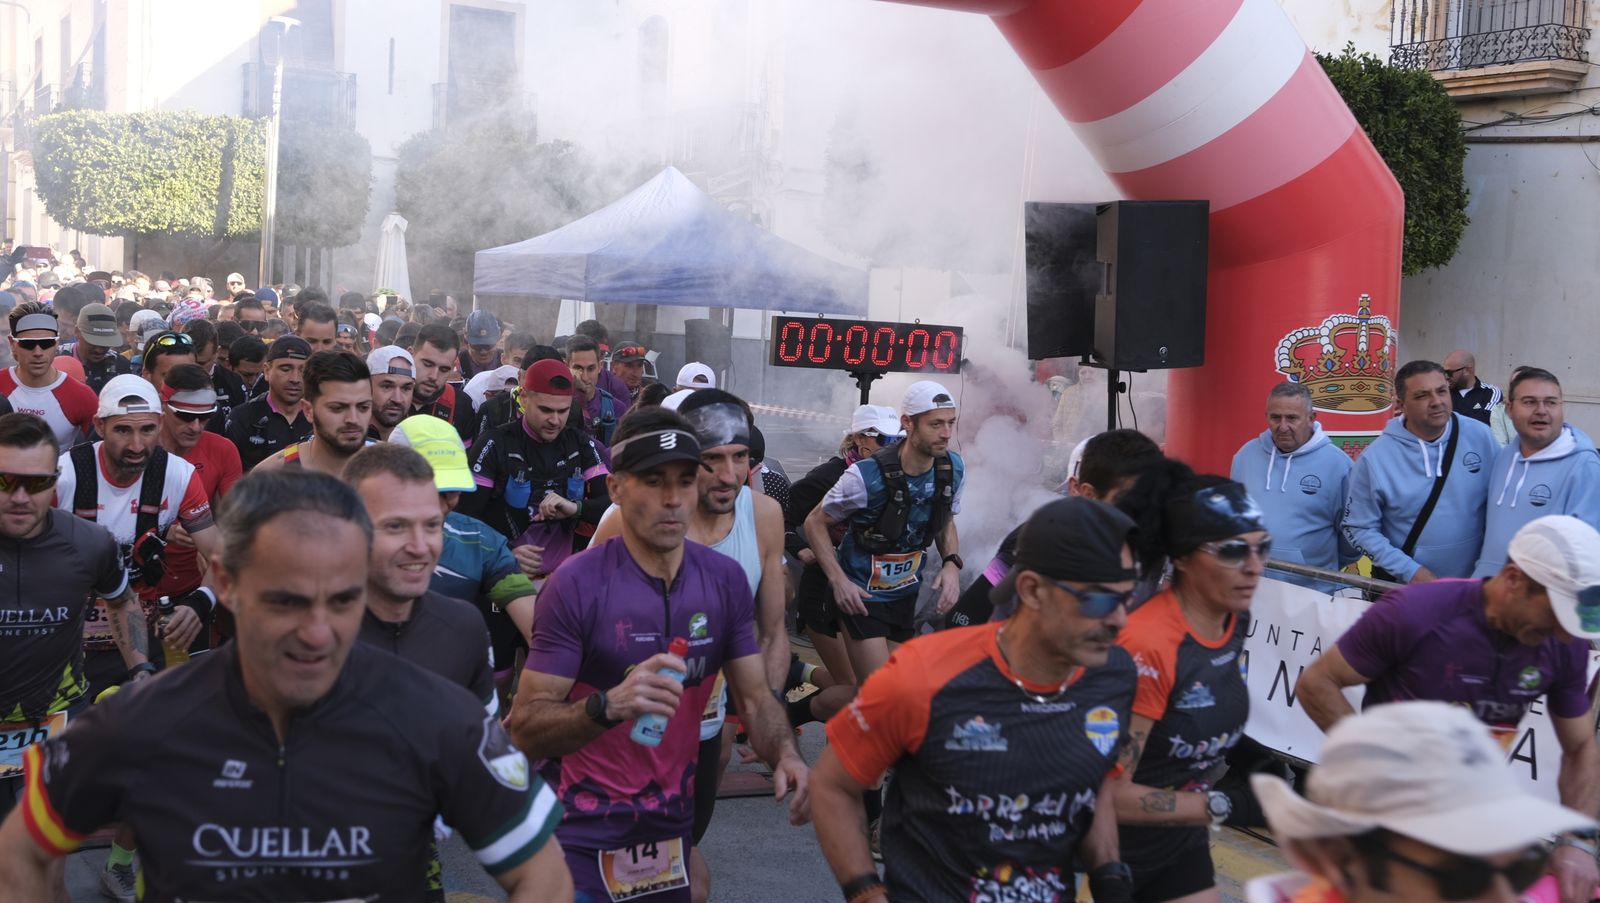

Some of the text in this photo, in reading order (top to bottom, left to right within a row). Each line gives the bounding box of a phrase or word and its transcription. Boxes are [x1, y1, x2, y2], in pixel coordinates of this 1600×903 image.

[779, 321, 958, 369] 00:00:00
[17, 407, 46, 416] WONG
[881, 560, 914, 577] 150
[192, 822, 373, 858] CUELLAR
[624, 839, 659, 865] 14
